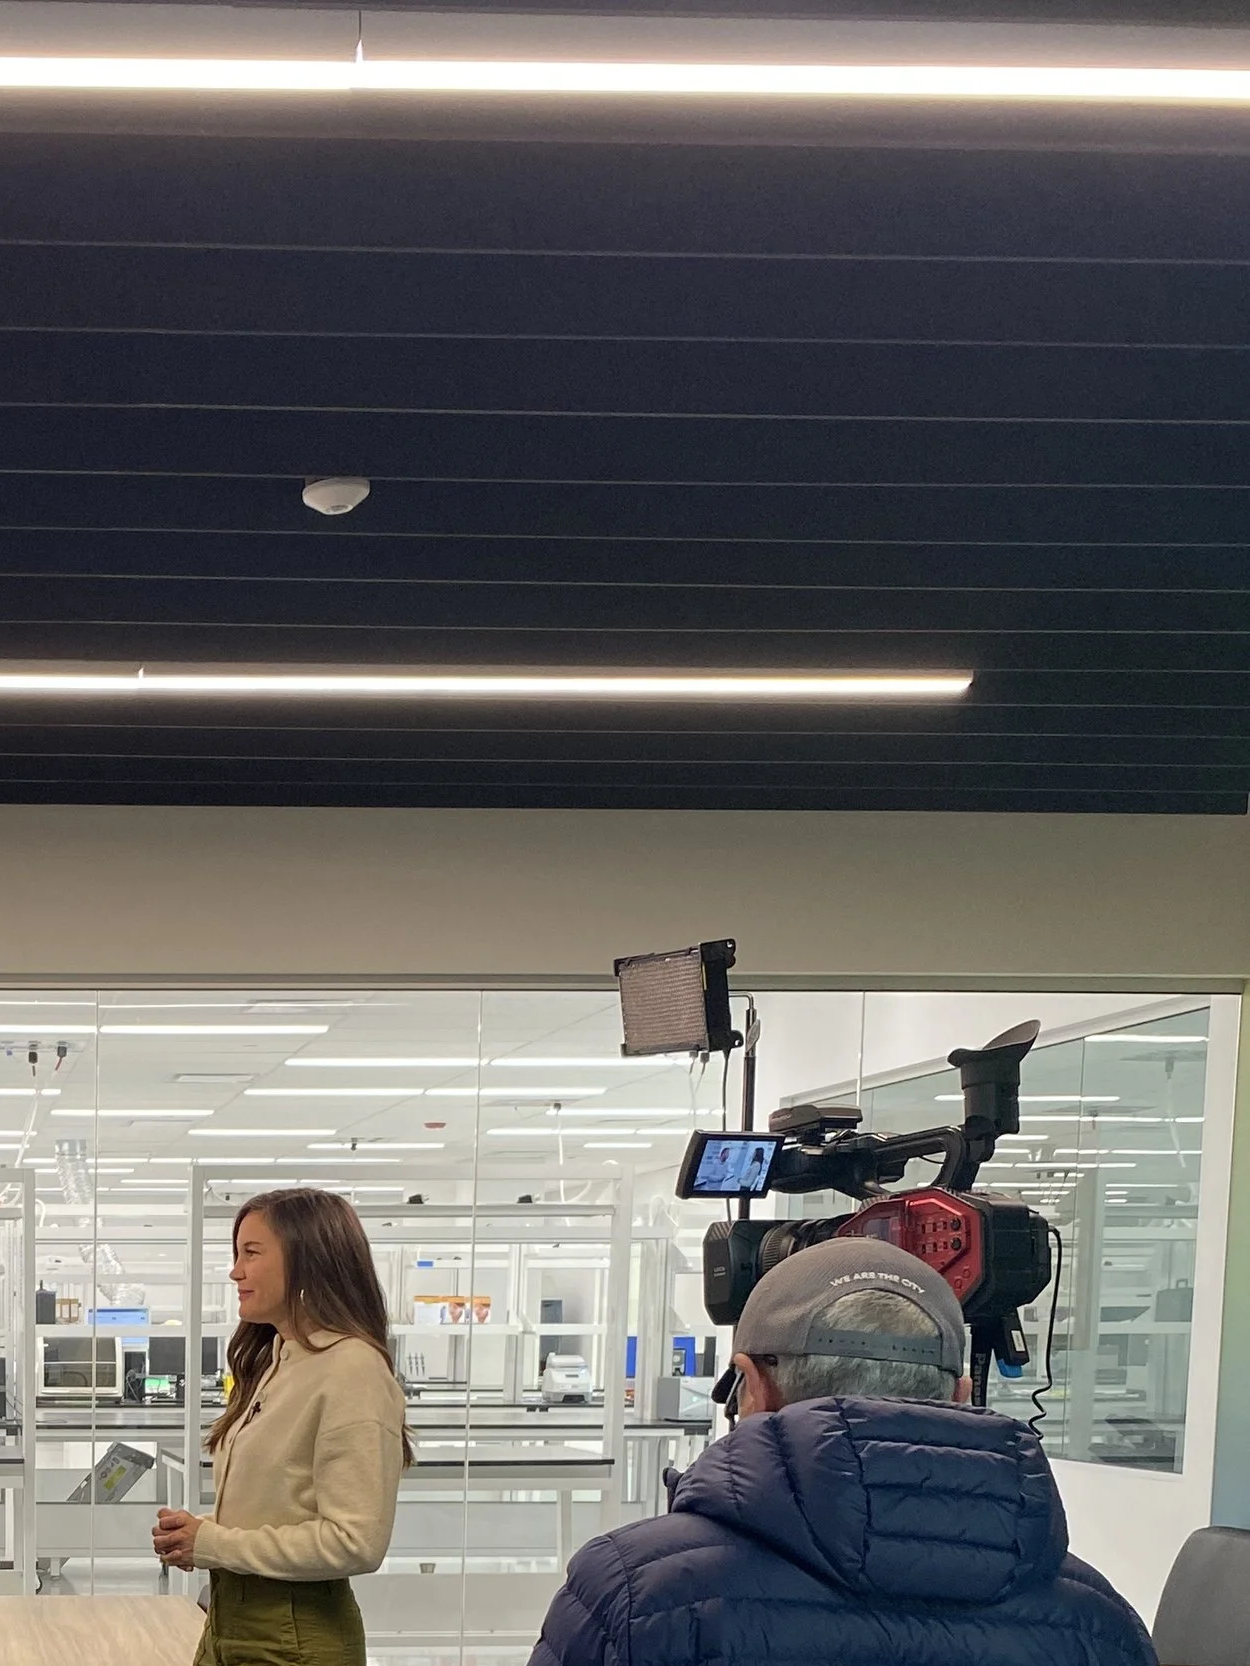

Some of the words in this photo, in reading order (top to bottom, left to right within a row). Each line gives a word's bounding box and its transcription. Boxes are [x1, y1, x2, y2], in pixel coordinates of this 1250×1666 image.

[830, 1275, 851, 1287] WE
[853, 1271, 876, 1281] ARE
[877, 1272, 900, 1284] THE
[901, 1278, 926, 1294] CITY
[973, 1352, 987, 1407] Panas
